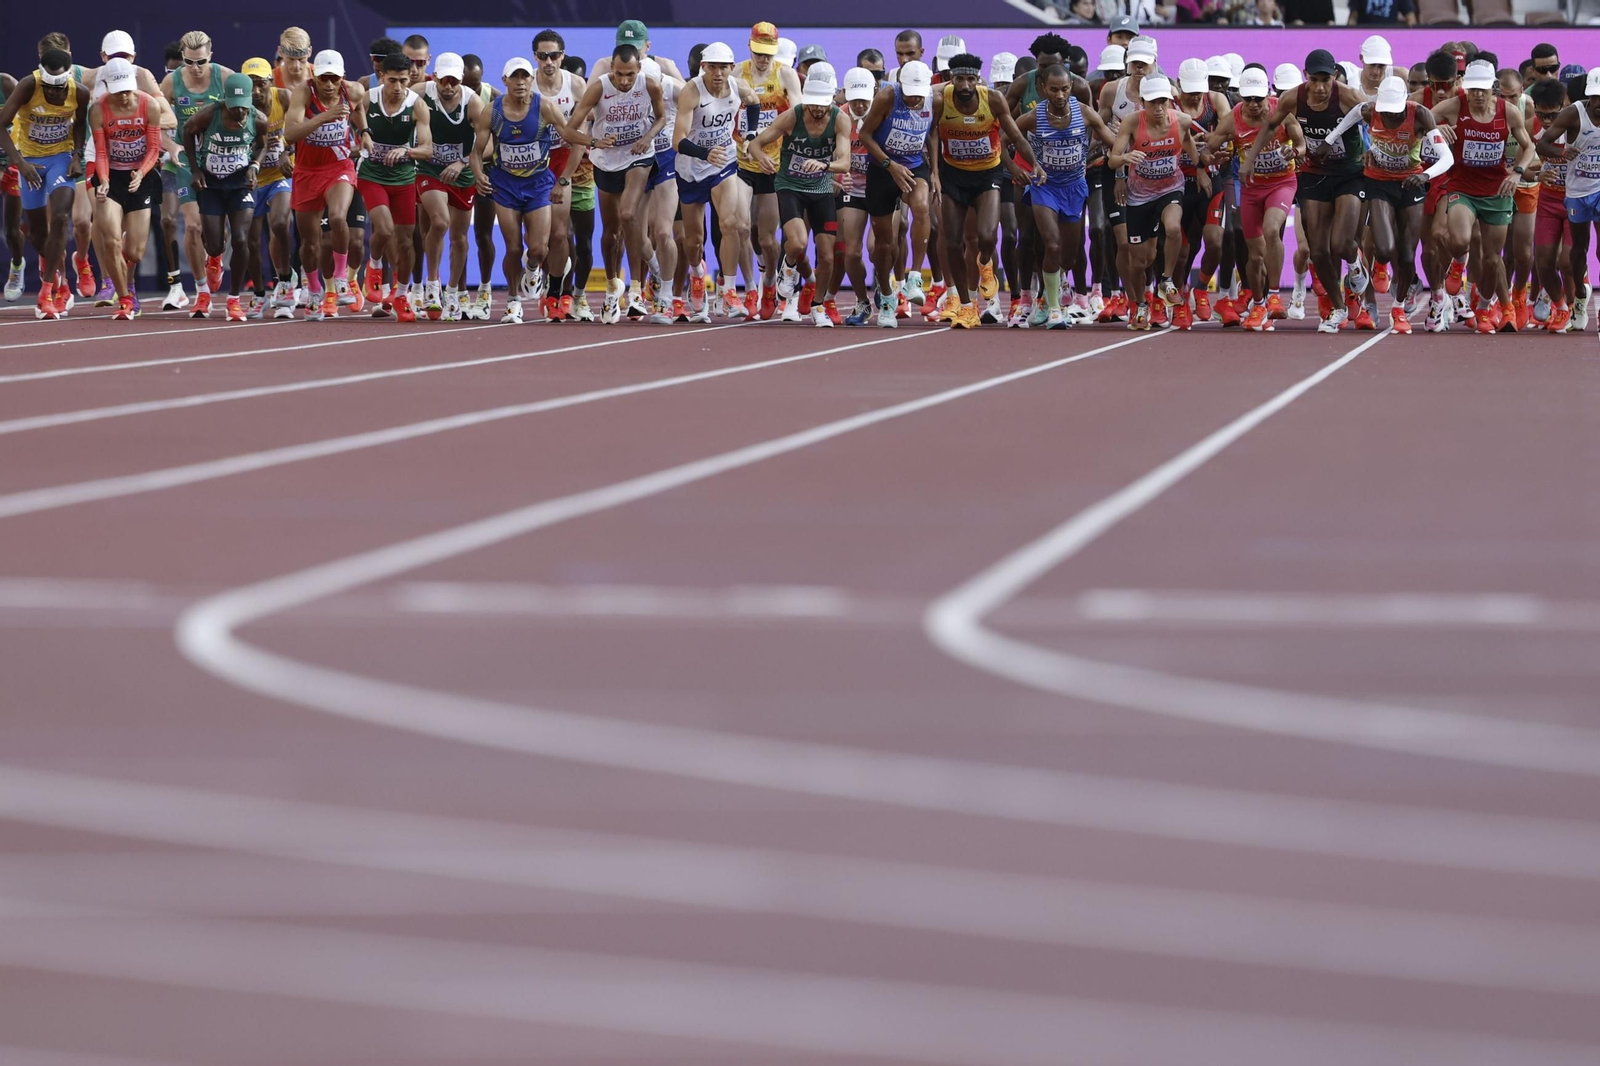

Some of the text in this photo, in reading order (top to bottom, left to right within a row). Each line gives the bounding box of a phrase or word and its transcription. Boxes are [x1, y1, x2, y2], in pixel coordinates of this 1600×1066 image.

[609, 104, 640, 115] GREAT
[606, 112, 642, 122] BRITAIN
[702, 112, 732, 128] USA
[759, 112, 775, 120] DK
[43, 123, 69, 131] TDK
[321, 123, 344, 132] TDK
[614, 124, 639, 132] TDK
[1305, 127, 1336, 135] SUDA
[111, 129, 143, 139] JAPAN
[310, 132, 346, 141] CHAMPI
[707, 127, 730, 138] TDK
[902, 132, 923, 142] TDK
[948, 129, 988, 137] GERMANY
[1464, 128, 1500, 139] MOROCCO
[121, 138, 146, 150] TDK
[697, 133, 730, 148] ALBERTSON
[887, 139, 923, 151] BAT-OCHIR
[961, 138, 987, 148] TDK
[112, 145, 148, 157] KONDO
[208, 141, 250, 155] IRELAND
[435, 144, 459, 153] TDK
[509, 145, 537, 154] TDK
[788, 142, 835, 157] ALGERI
[952, 146, 989, 155] PETROS
[1055, 147, 1079, 156] TDK
[218, 154, 244, 163] TDK
[507, 153, 534, 163] JAMI
[1045, 153, 1080, 164] TEFERI
[1258, 152, 1279, 160] TDK
[1381, 154, 1406, 163] TDK
[1464, 150, 1501, 160] EL AARABY
[1149, 159, 1173, 167] TDK
[1138, 165, 1174, 175] YOSHIDA
